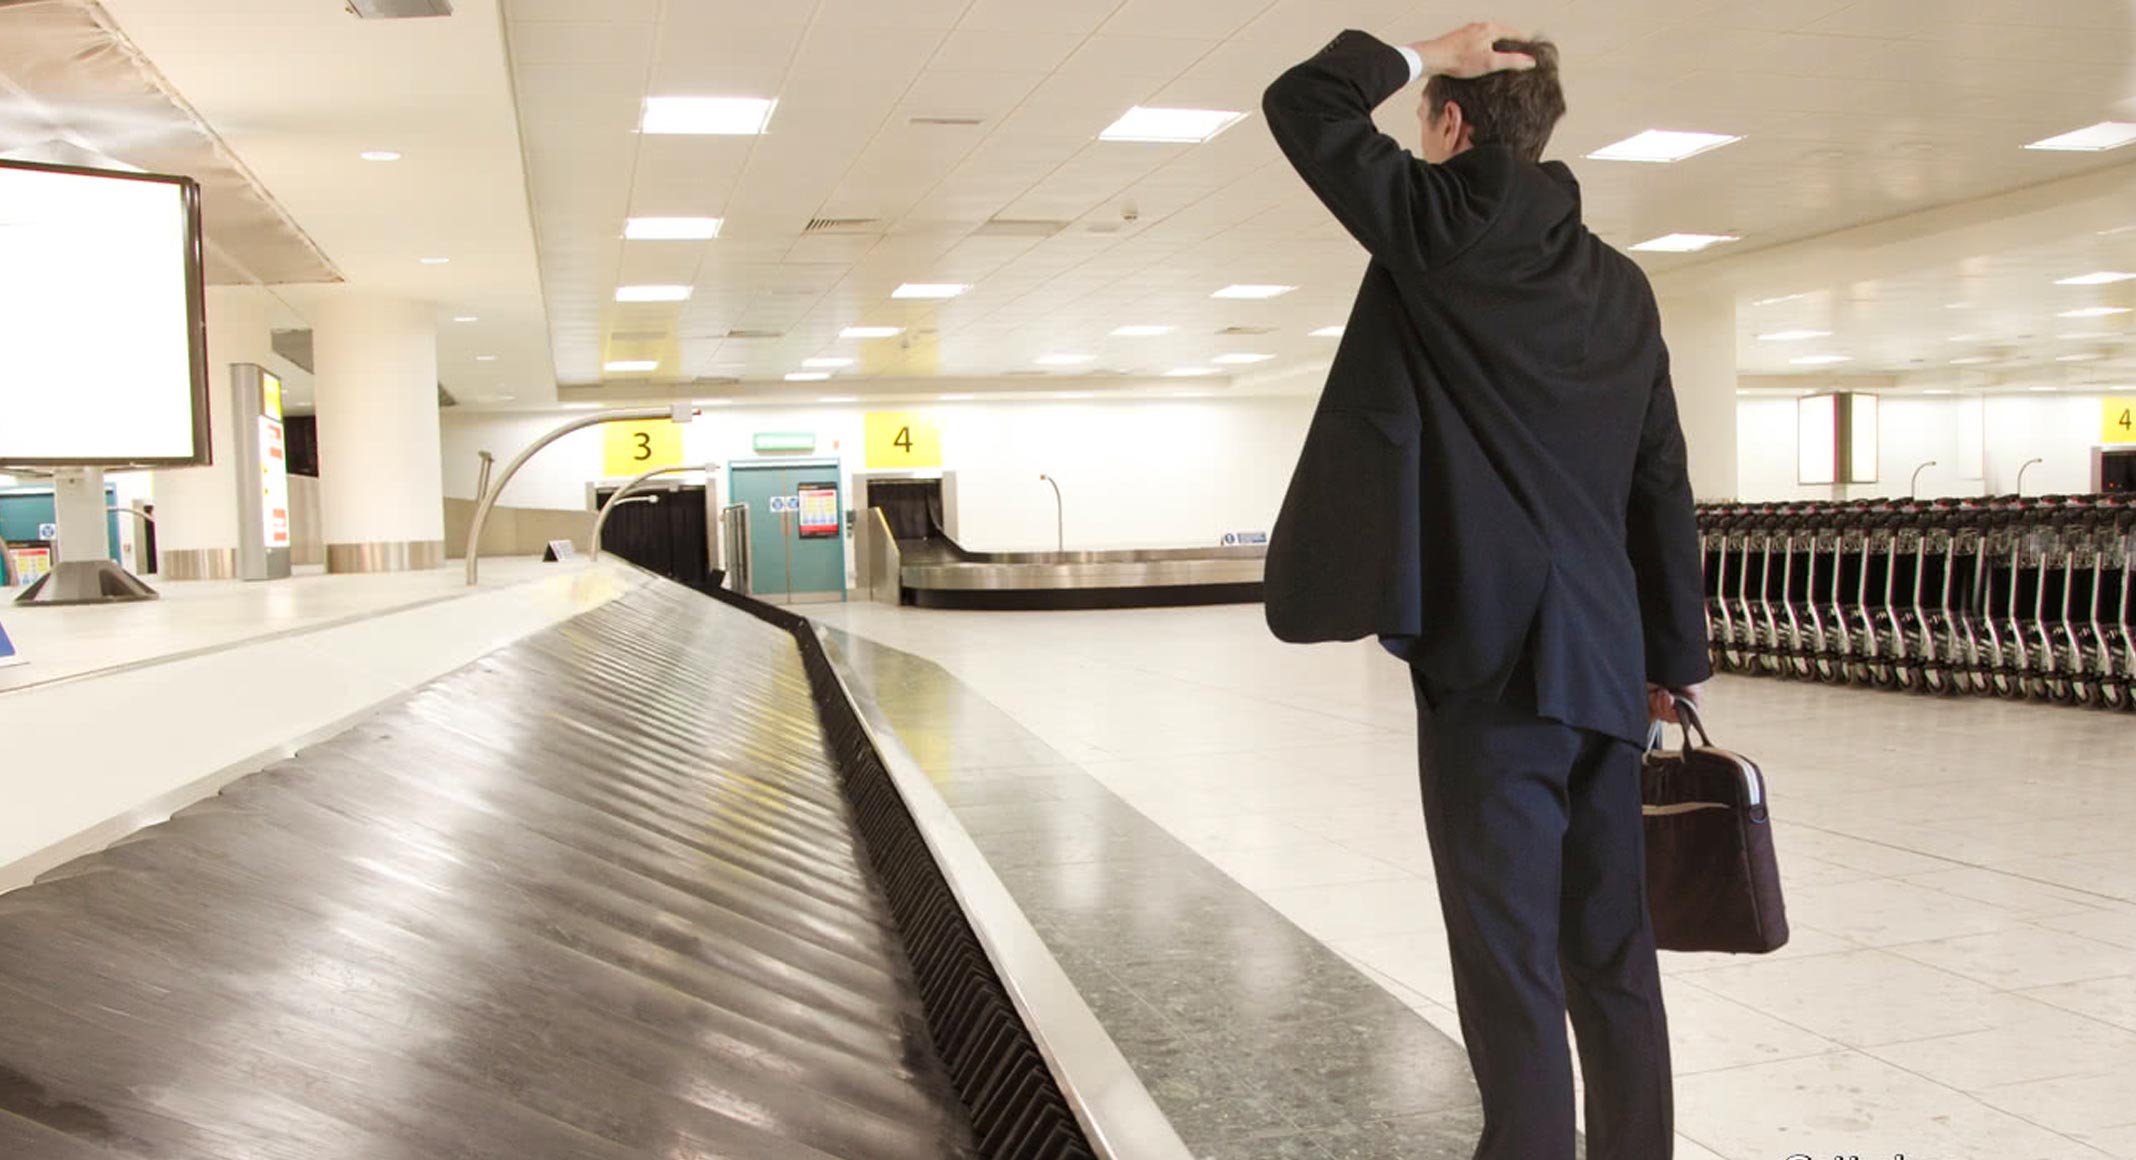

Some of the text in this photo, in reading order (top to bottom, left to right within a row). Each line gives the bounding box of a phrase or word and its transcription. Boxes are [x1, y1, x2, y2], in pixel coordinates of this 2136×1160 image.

[2119, 409, 2131, 430] 4
[634, 433, 652, 461] 3
[894, 427, 913, 453] 4
